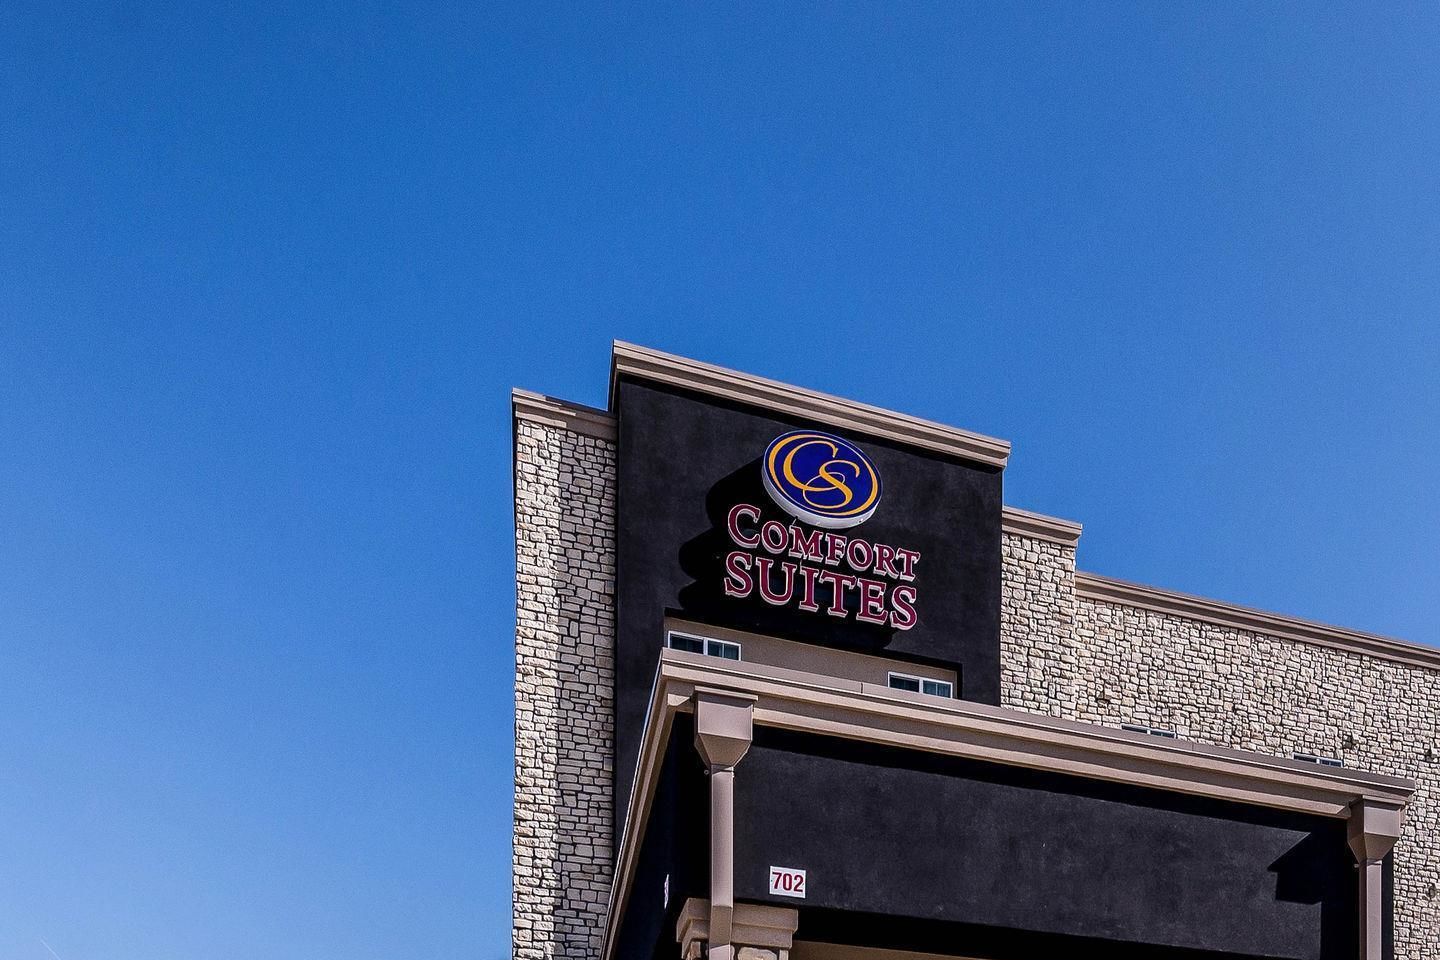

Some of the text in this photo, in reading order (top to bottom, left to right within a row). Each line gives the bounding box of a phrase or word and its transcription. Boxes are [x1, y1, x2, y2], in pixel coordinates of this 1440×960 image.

[727, 503, 921, 581] COMFORT
[724, 551, 918, 631] SUITES
[772, 871, 804, 893] 702
